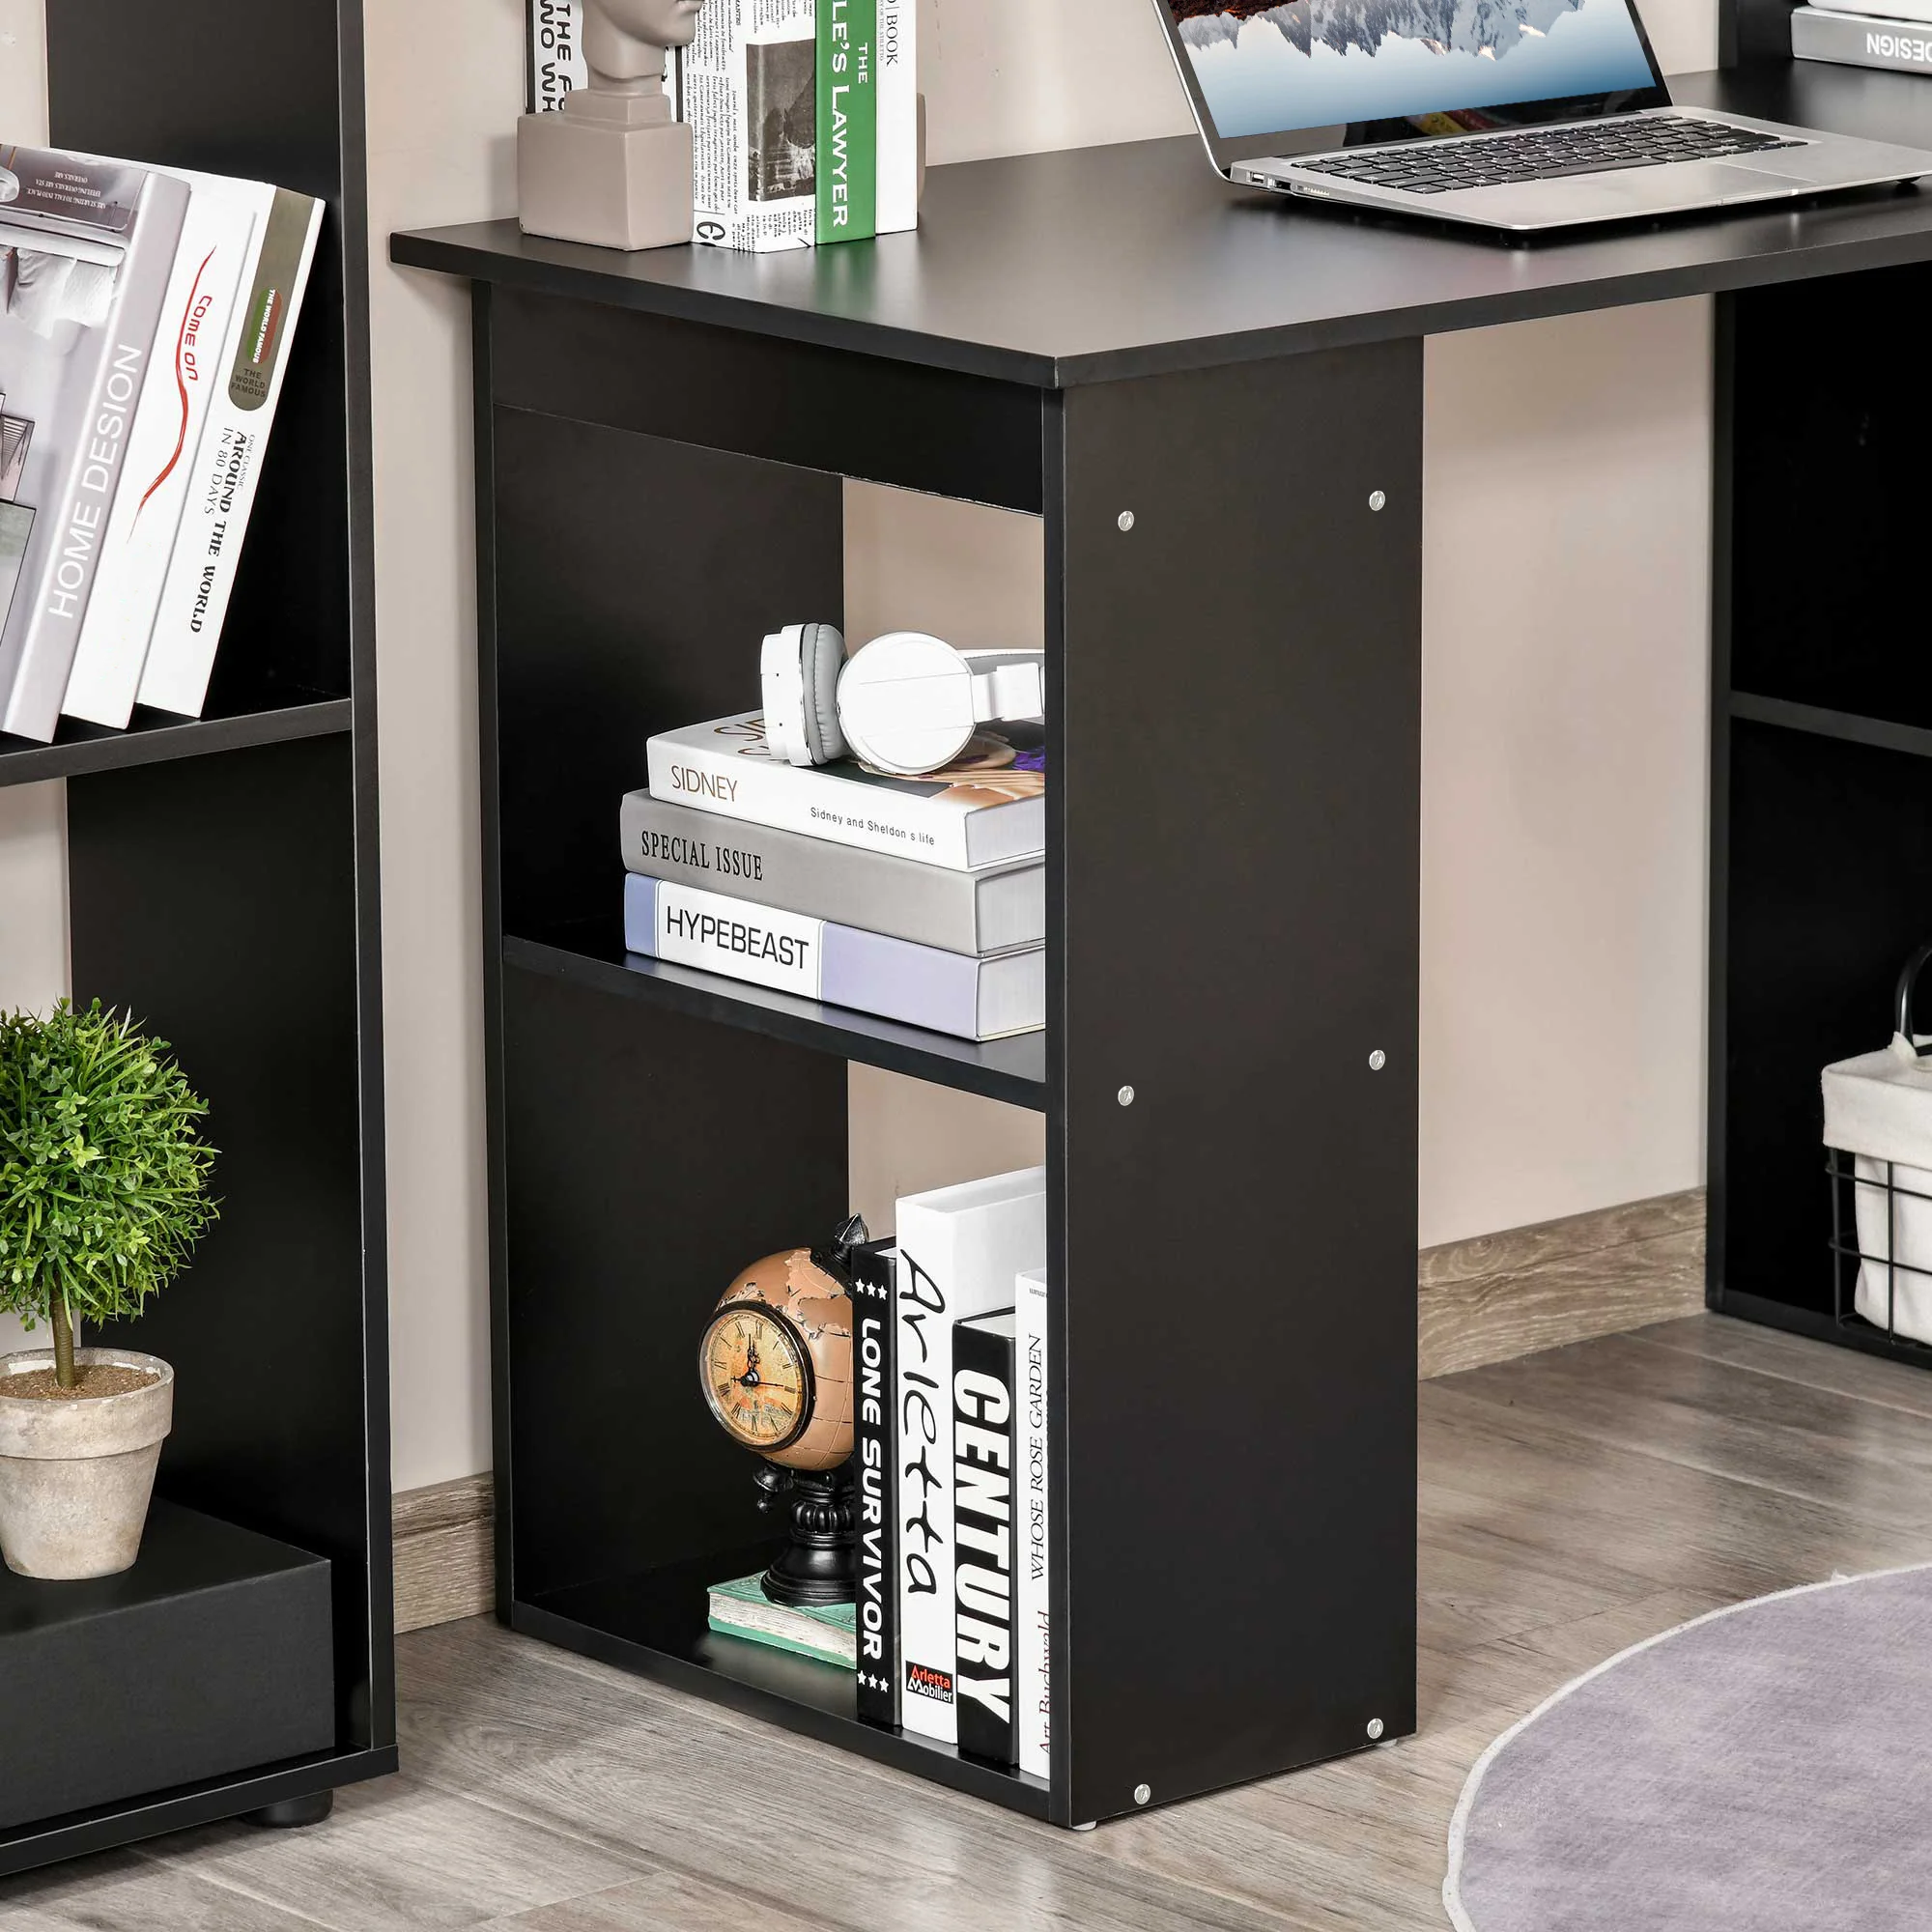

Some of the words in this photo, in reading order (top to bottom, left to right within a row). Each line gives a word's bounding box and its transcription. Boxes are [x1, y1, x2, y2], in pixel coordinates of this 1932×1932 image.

[556, 4, 571, 61] THE
[886, 14, 898, 68] BOOK
[858, 43, 868, 84] THE
[832, 85, 850, 227] LAWYER
[231, 383, 267, 398] FAMOUS
[235, 375, 266, 389] WORLD
[243, 368, 263, 380] THE
[214, 450, 228, 469] 80
[221, 428, 234, 445] IN
[204, 472, 224, 516] DAYS
[219, 431, 247, 514] AROUND
[48, 501, 101, 618] HOME
[207, 521, 227, 556] THE
[189, 564, 216, 633] WORLD
[671, 765, 738, 802] SIDNEY
[810, 807, 843, 826] Sidney
[846, 816, 865, 829] and
[867, 819, 906, 838] Sheldon
[919, 833, 935, 846] life
[640, 830, 710, 869] SPECIAL
[715, 847, 763, 881] ISSUE
[666, 905, 810, 969] HYPEBEAST
[862, 1318, 881, 1426] LONE
[1029, 1333, 1042, 1429] GARDEN
[1029, 1436, 1043, 1493] ROSE
[862, 1438, 882, 1660] SURVIVOR
[953, 1369, 1010, 1724] CENTURY
[1030, 1499, 1044, 1580] WHOSE
[907, 1676, 952, 1702] Mobilier
[910, 1664, 951, 1689] Arletta
